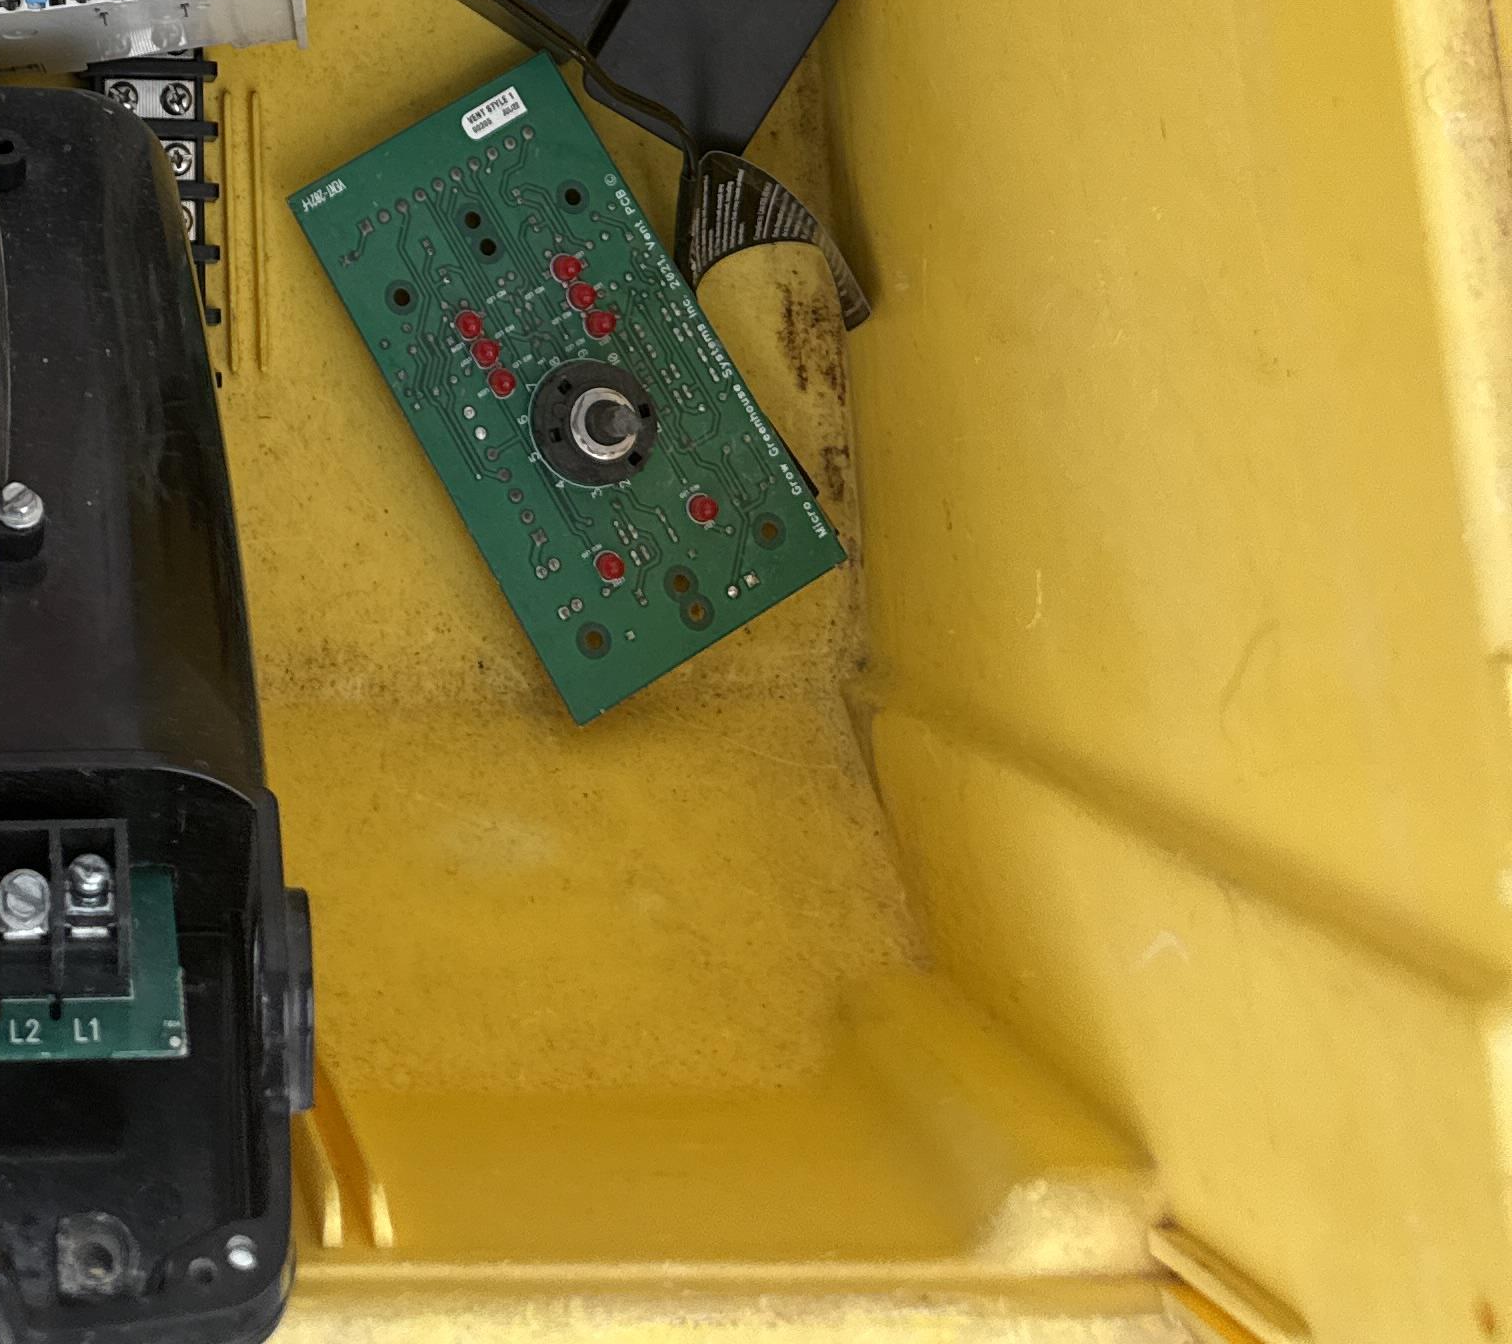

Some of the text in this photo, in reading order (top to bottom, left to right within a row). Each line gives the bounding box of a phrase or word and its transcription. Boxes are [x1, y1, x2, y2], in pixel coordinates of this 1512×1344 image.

[466, 107, 486, 124] VENT
[484, 93, 509, 113] STYLE
[613, 186, 829, 539] Micro Grow Greenhouse Systems Inc. 2021, Vent PCB
[9, 1018, 41, 1043] L2
[74, 1017, 100, 1042] L1
